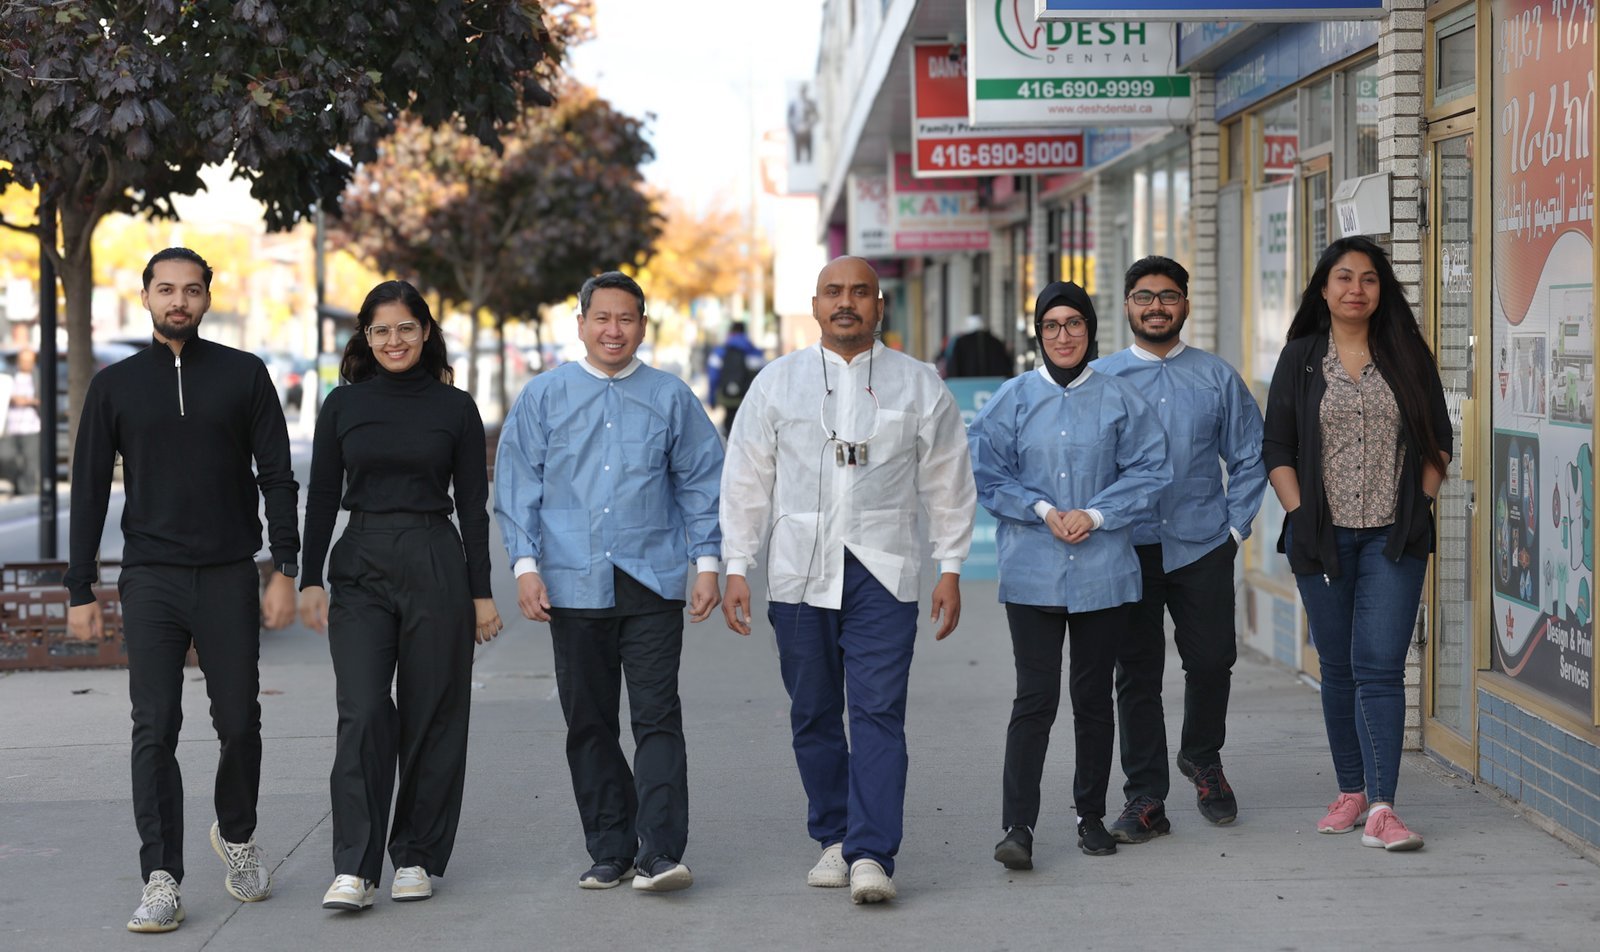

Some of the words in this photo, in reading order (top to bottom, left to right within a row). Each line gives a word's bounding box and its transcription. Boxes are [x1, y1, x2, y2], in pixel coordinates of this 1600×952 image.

[1045, 21, 1147, 46] DESH
[1046, 53, 1149, 64] DENTAL
[1017, 80, 1155, 98] 416-690-9999
[1047, 103, 1153, 114] www.deshdental.ca
[920, 124, 955, 135] Family
[930, 141, 1078, 167] 416-690-9000
[1546, 618, 1569, 653] Design
[1569, 627, 1576, 651] &
[1559, 654, 1589, 689] Services
